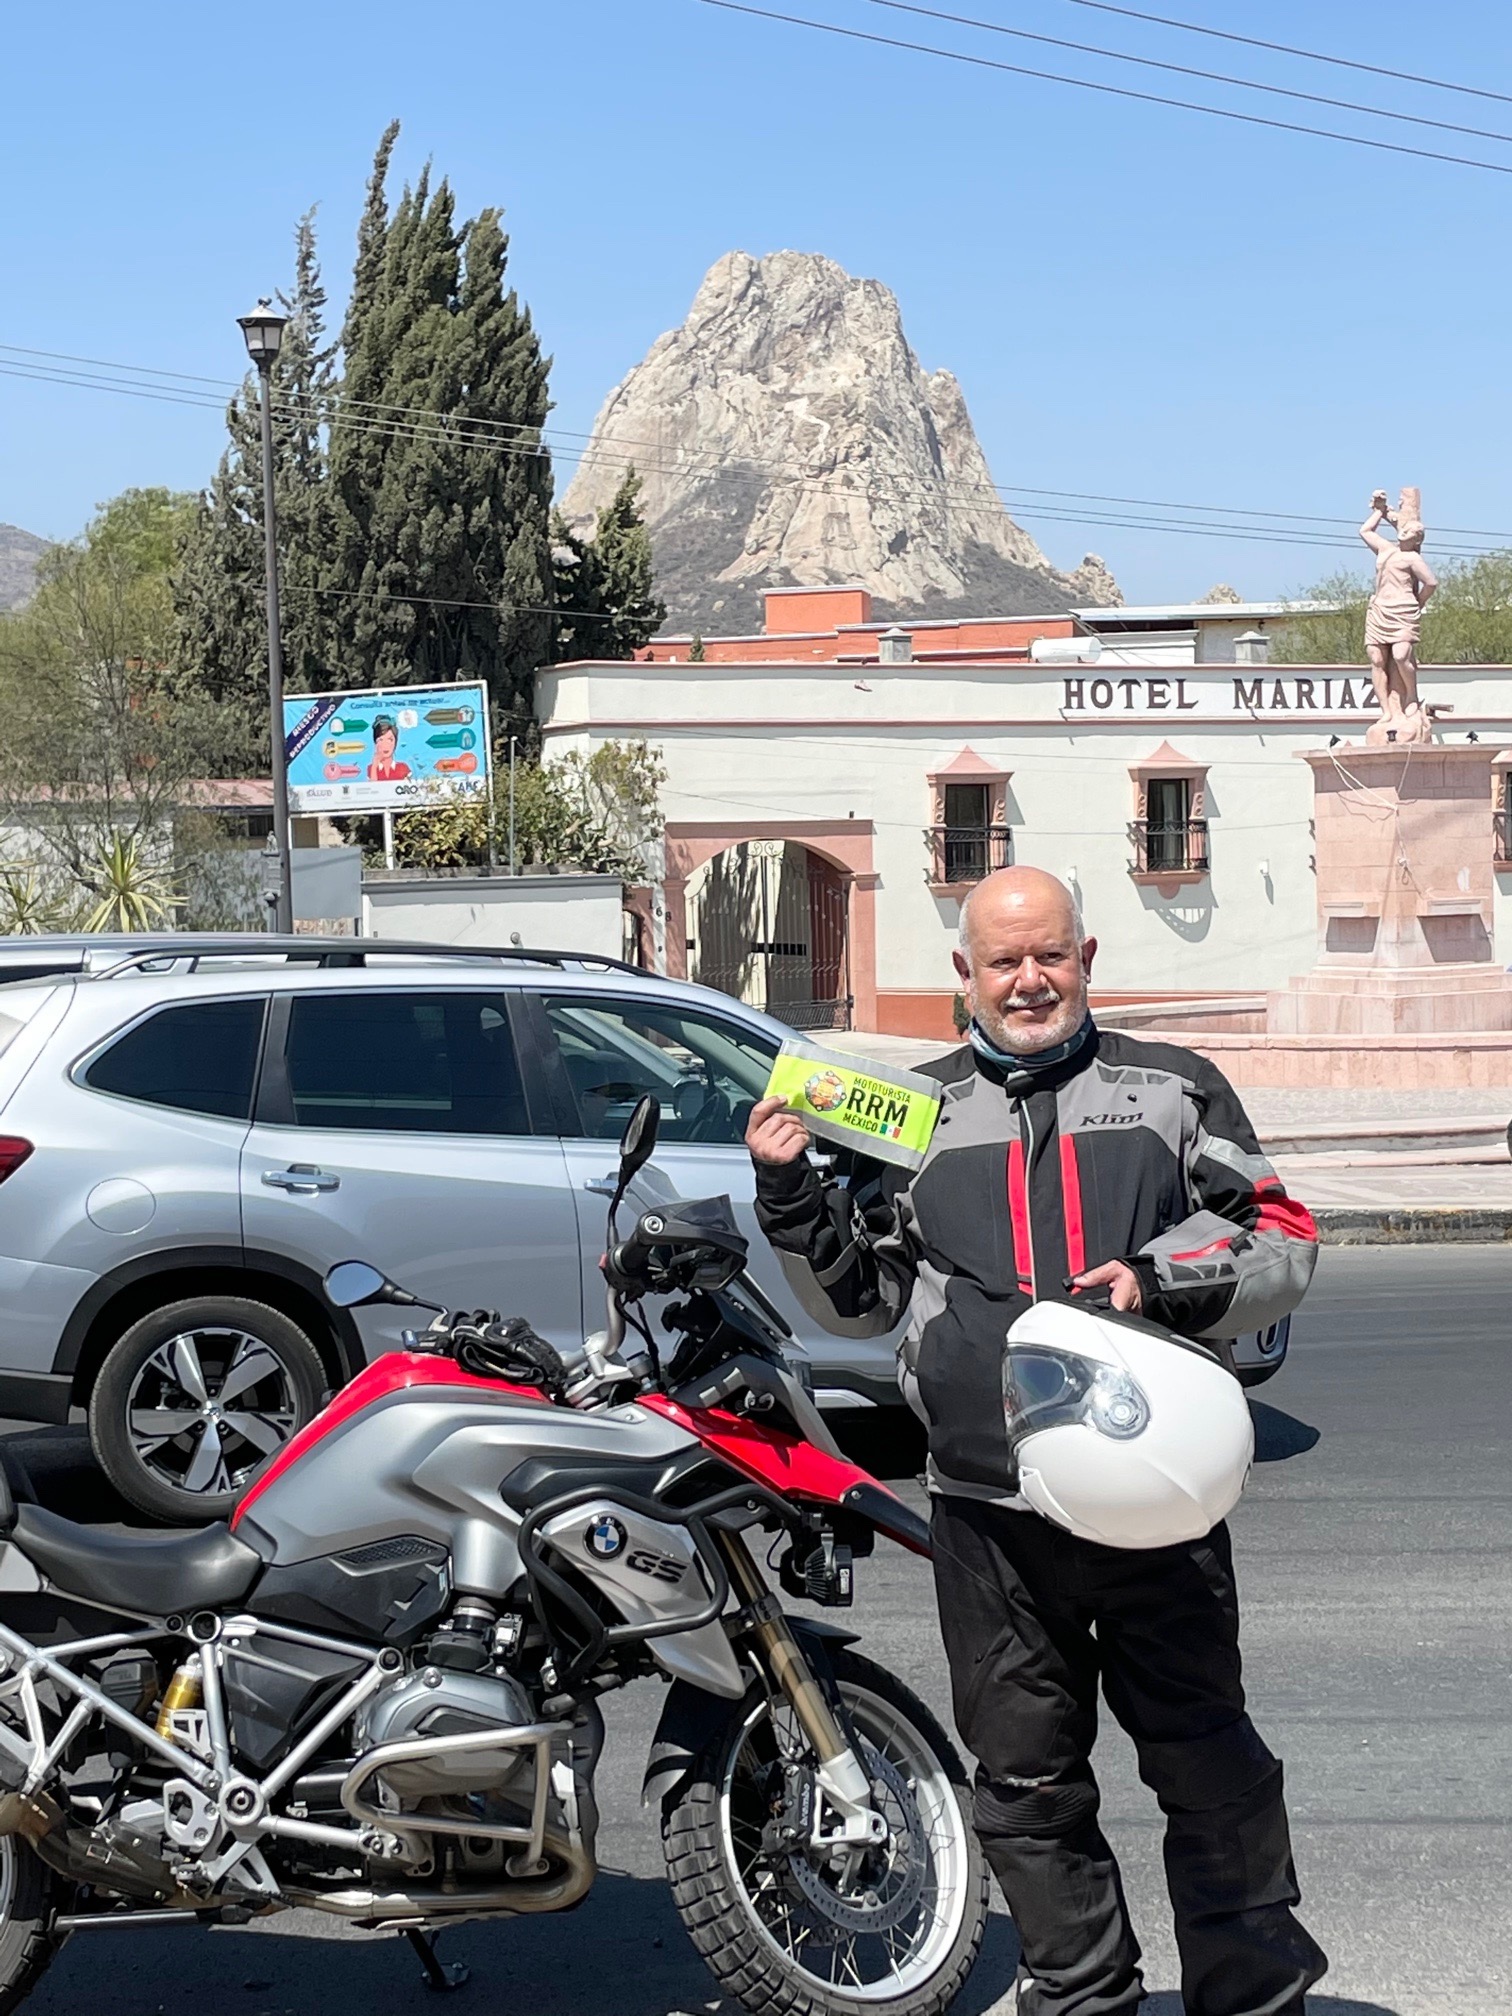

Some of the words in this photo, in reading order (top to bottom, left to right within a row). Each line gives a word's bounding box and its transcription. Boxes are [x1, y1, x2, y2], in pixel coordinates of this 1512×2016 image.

[1063, 678, 1199, 709] HOTEL
[1232, 677, 1425, 709] MARIAZ
[289, 703, 336, 758] REPRODUCTIVO
[292, 705, 319, 737] RIESGO
[846, 1086, 909, 1127] RRM
[626, 1551, 688, 1583] GS
